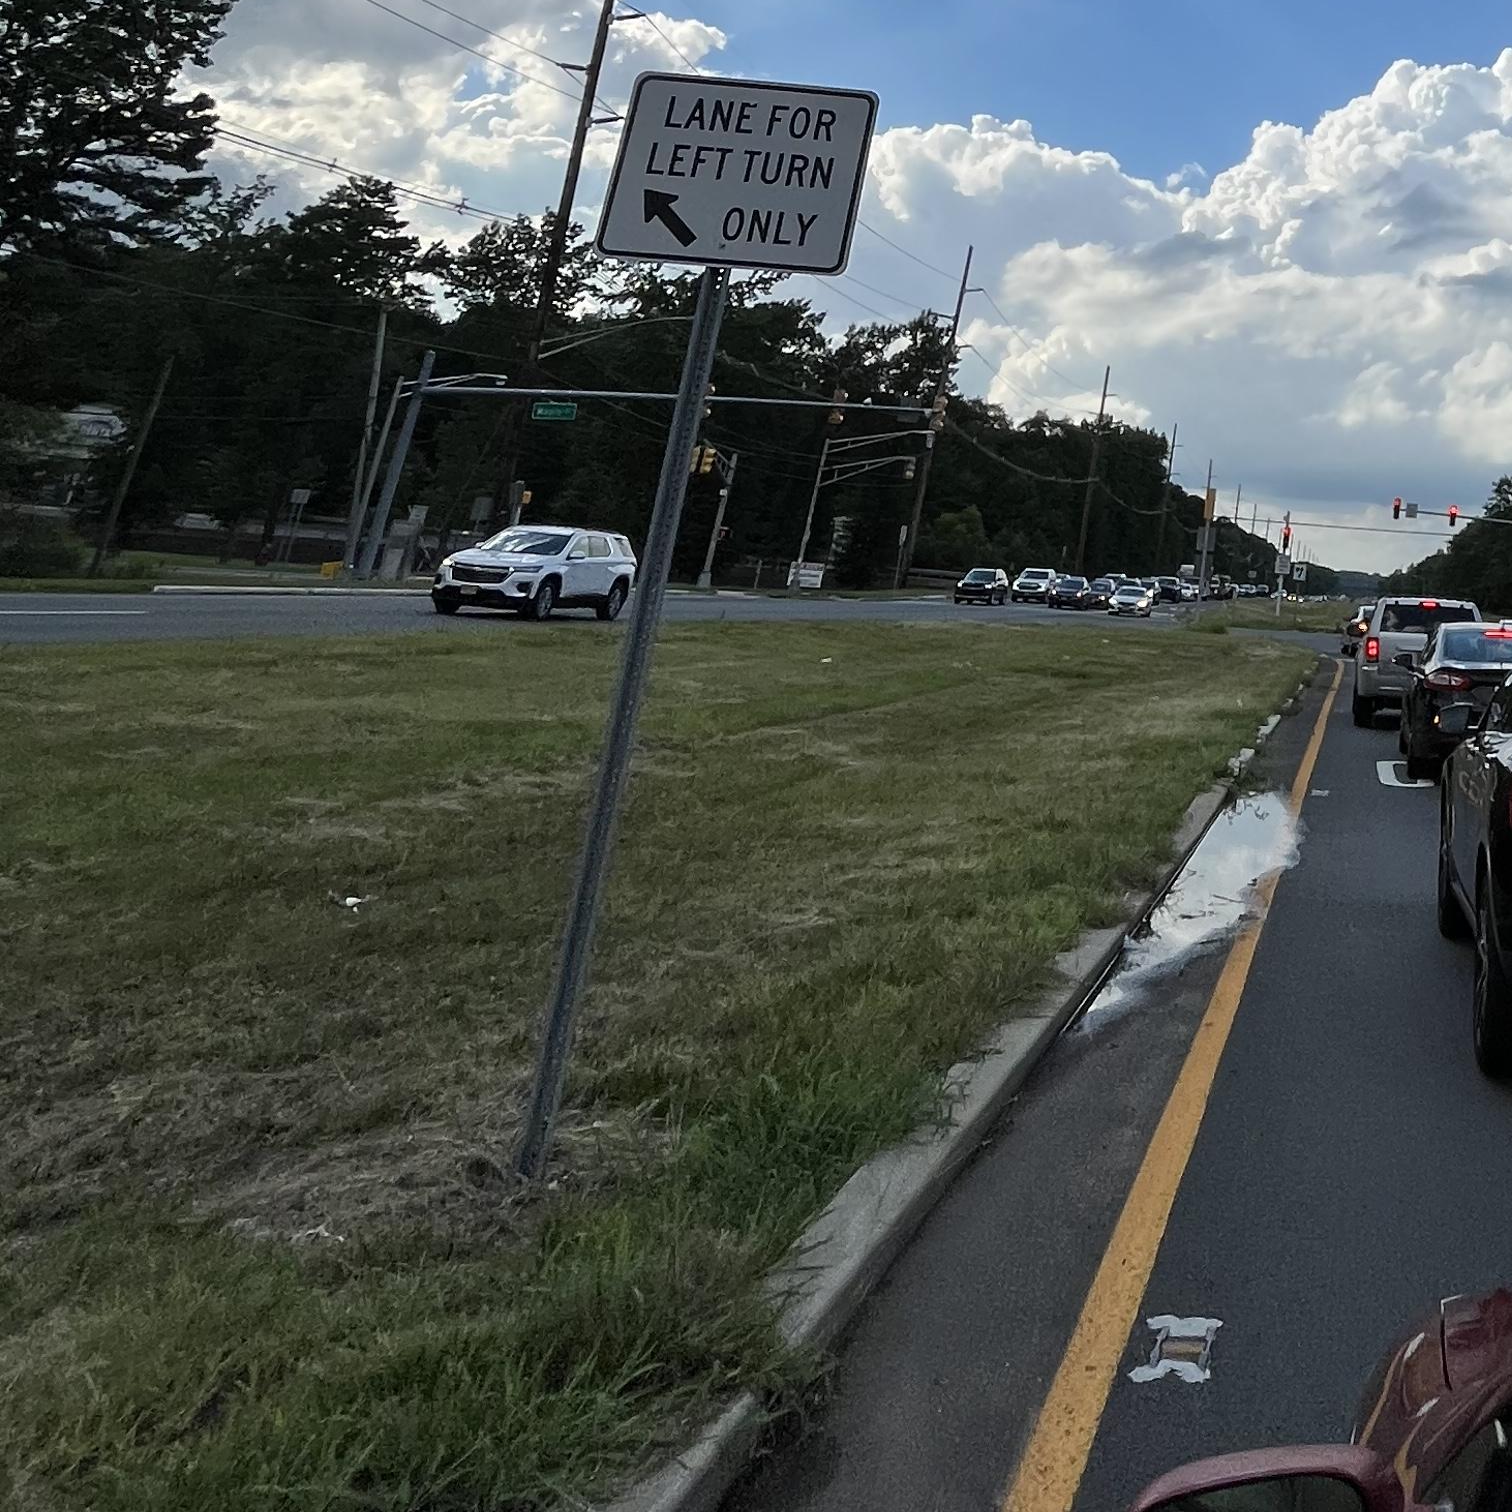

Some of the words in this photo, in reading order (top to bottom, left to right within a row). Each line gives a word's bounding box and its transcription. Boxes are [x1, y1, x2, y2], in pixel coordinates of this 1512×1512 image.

[664, 95, 757, 135] LANE
[766, 104, 837, 141] FOR
[645, 142, 733, 180] LEFT
[743, 150, 834, 189] TURN
[722, 207, 818, 247] ONLY
